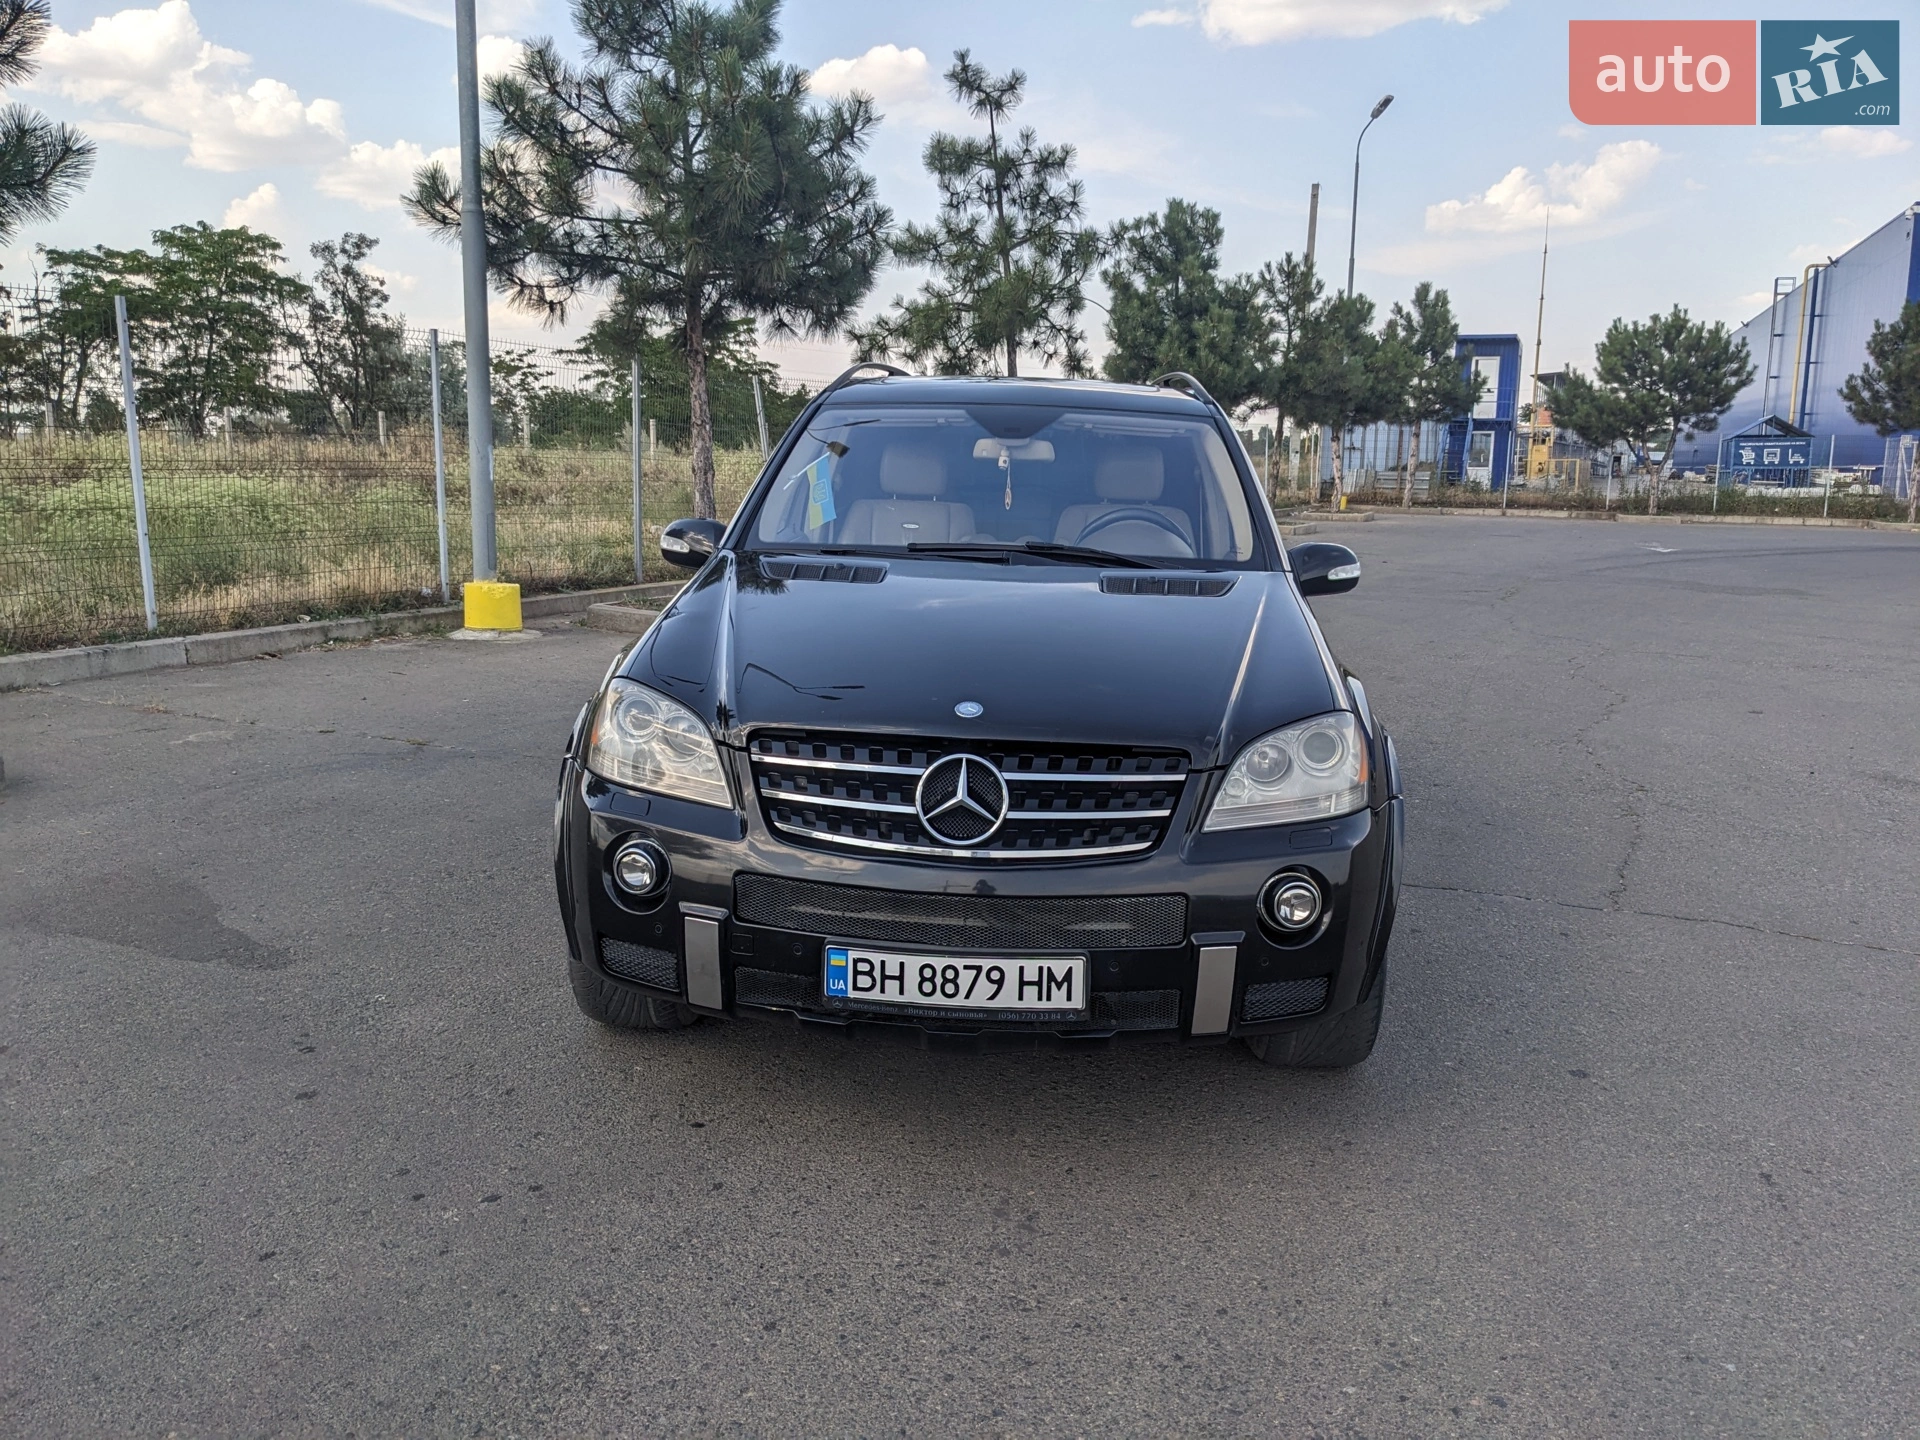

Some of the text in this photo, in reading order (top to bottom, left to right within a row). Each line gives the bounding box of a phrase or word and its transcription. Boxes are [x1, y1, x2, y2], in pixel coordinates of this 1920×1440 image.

[829, 978, 846, 991] UA
[851, 956, 1073, 1003] BH 8879 HM
[848, 1002, 898, 1013] Mercedes-Benz
[998, 1012, 1019, 1020] (056)
[1021, 1012, 1037, 1020] 770
[1039, 1012, 1049, 1020] 33
